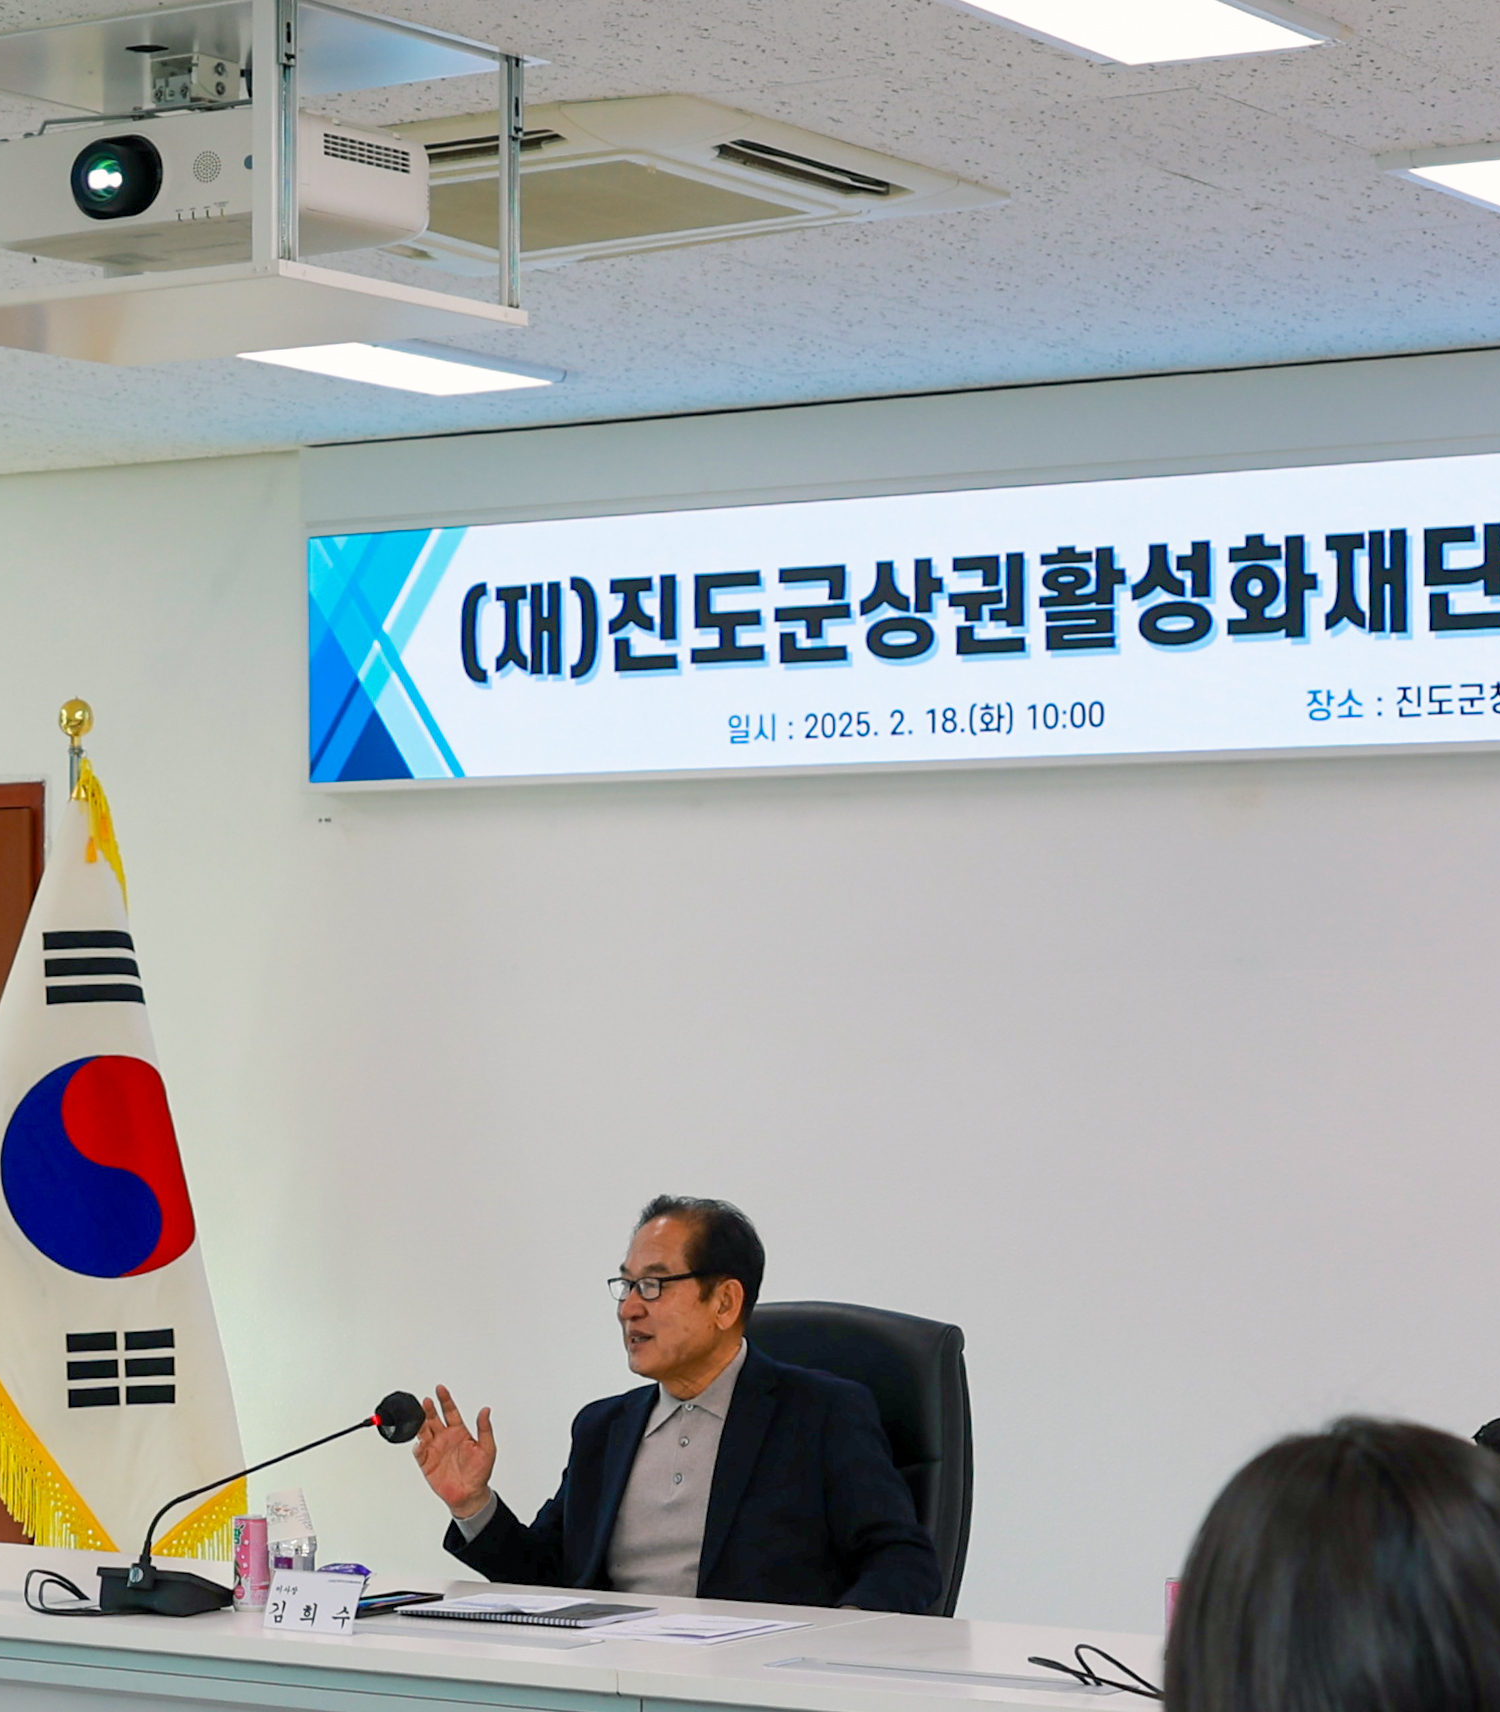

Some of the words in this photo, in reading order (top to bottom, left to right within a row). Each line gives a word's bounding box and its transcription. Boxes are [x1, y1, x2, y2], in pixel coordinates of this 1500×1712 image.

[727, 714, 777, 744] 일시
[804, 712, 879, 740] 2025.
[889, 709, 914, 737] 2.
[926, 702, 1014, 736] 18.(화)
[1027, 701, 1105, 730] 10:00
[1307, 688, 1364, 721] 장소
